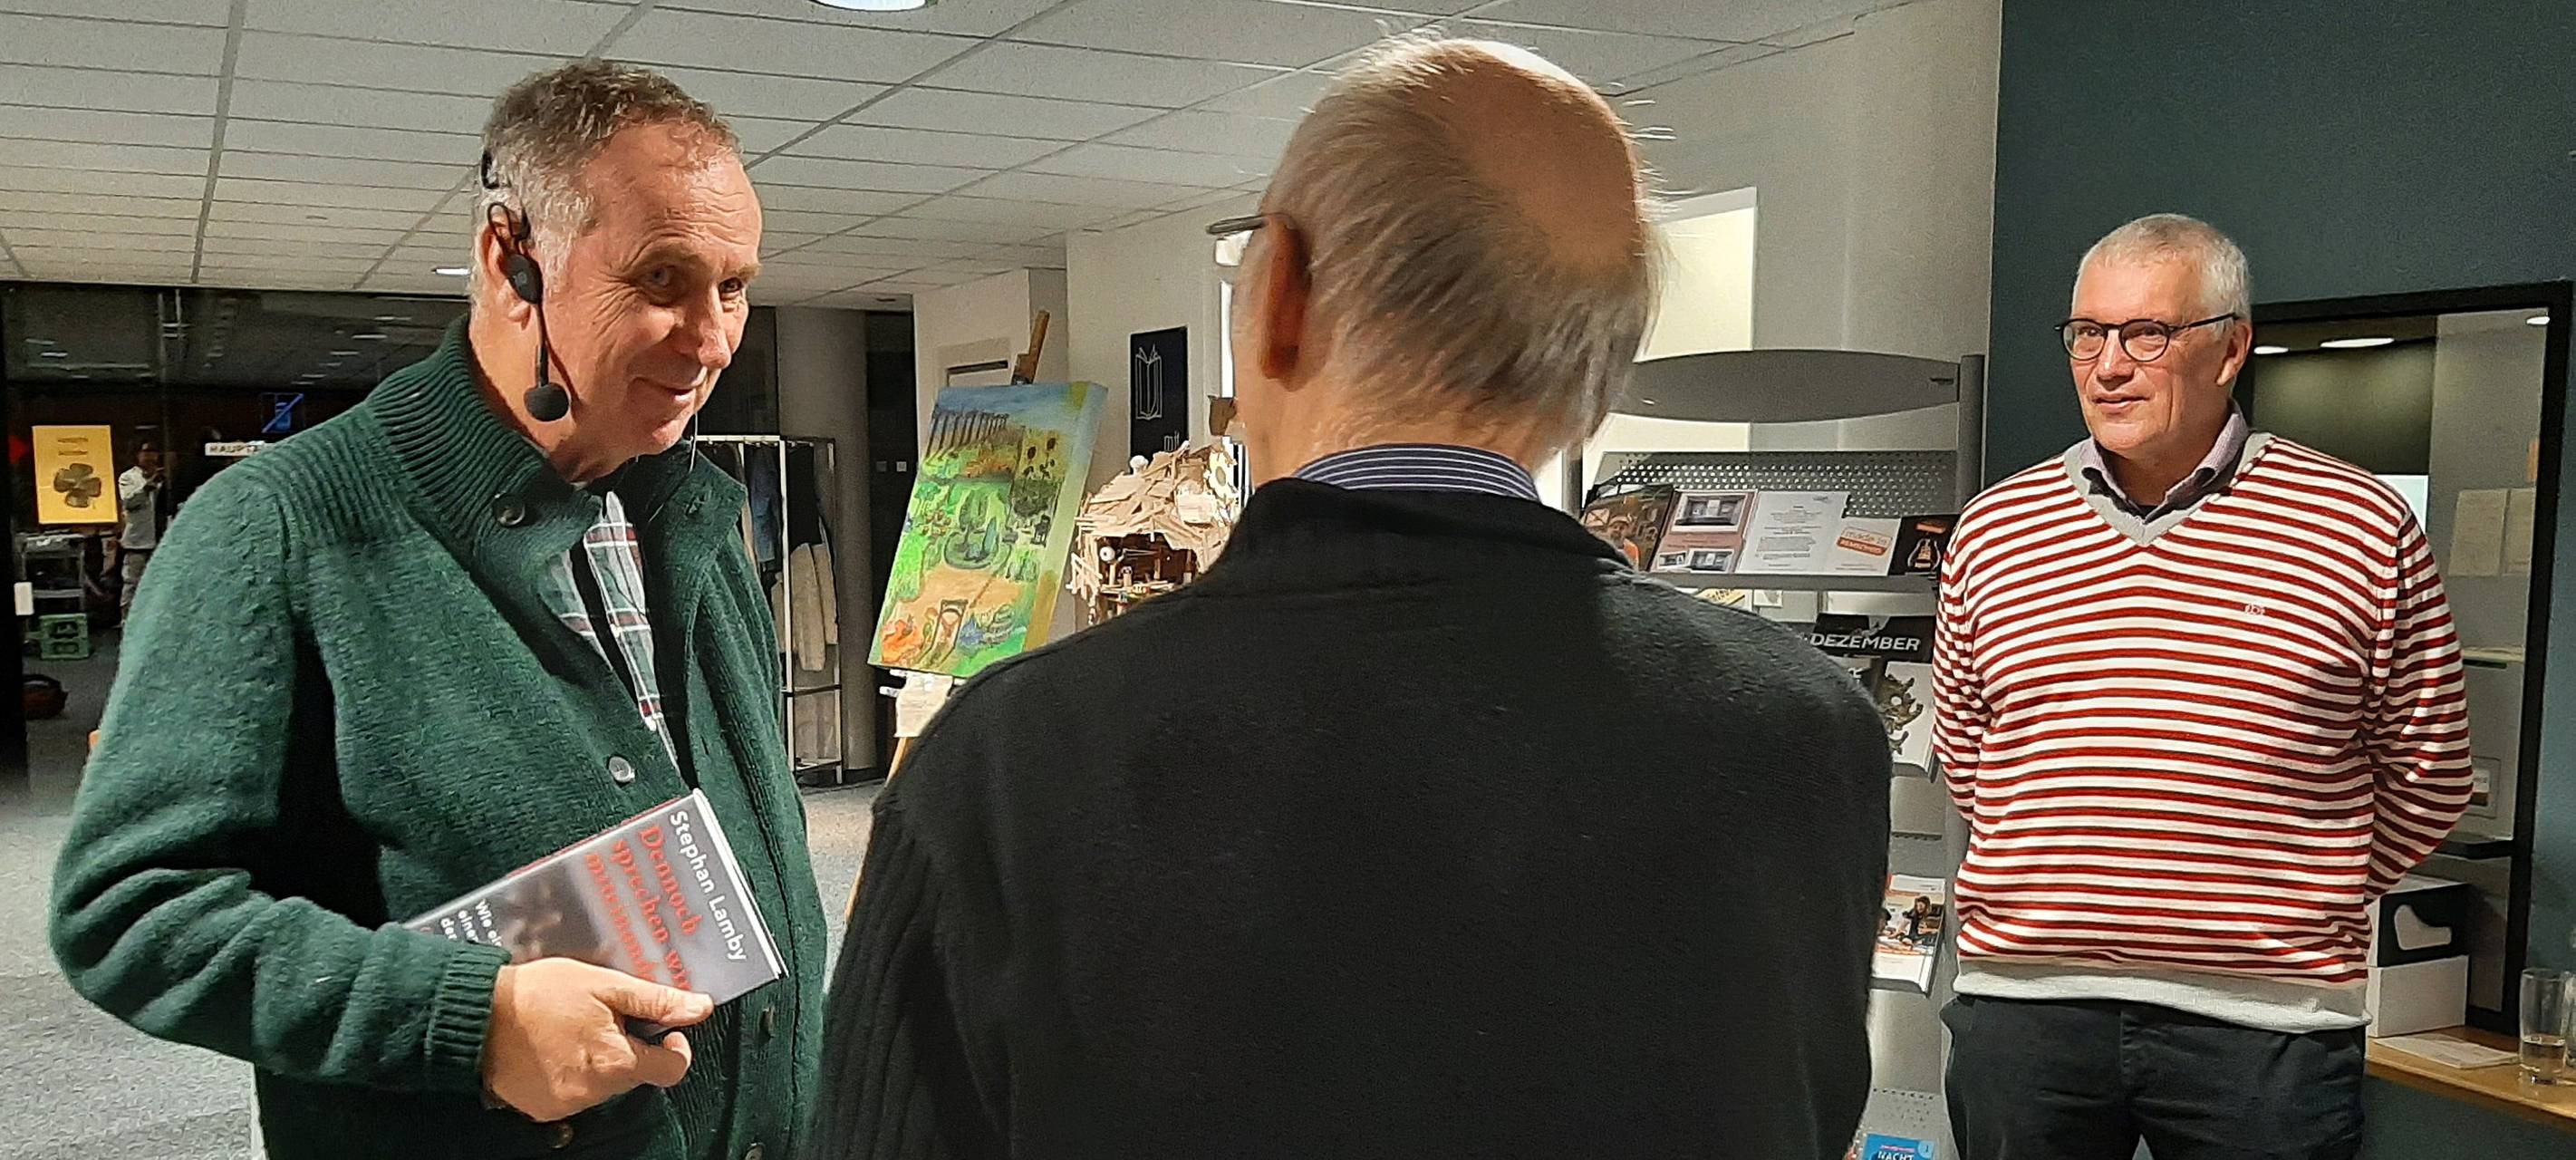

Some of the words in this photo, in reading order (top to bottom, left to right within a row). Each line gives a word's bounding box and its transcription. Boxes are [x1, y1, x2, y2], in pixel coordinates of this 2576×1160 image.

[1809, 633, 1921, 652] DEZEMBER
[476, 898, 492, 928] Wie
[610, 837, 670, 944] sprechen
[638, 825, 703, 936] Dennoch
[670, 810, 715, 894] Stephan
[709, 895, 748, 961] Lamby
